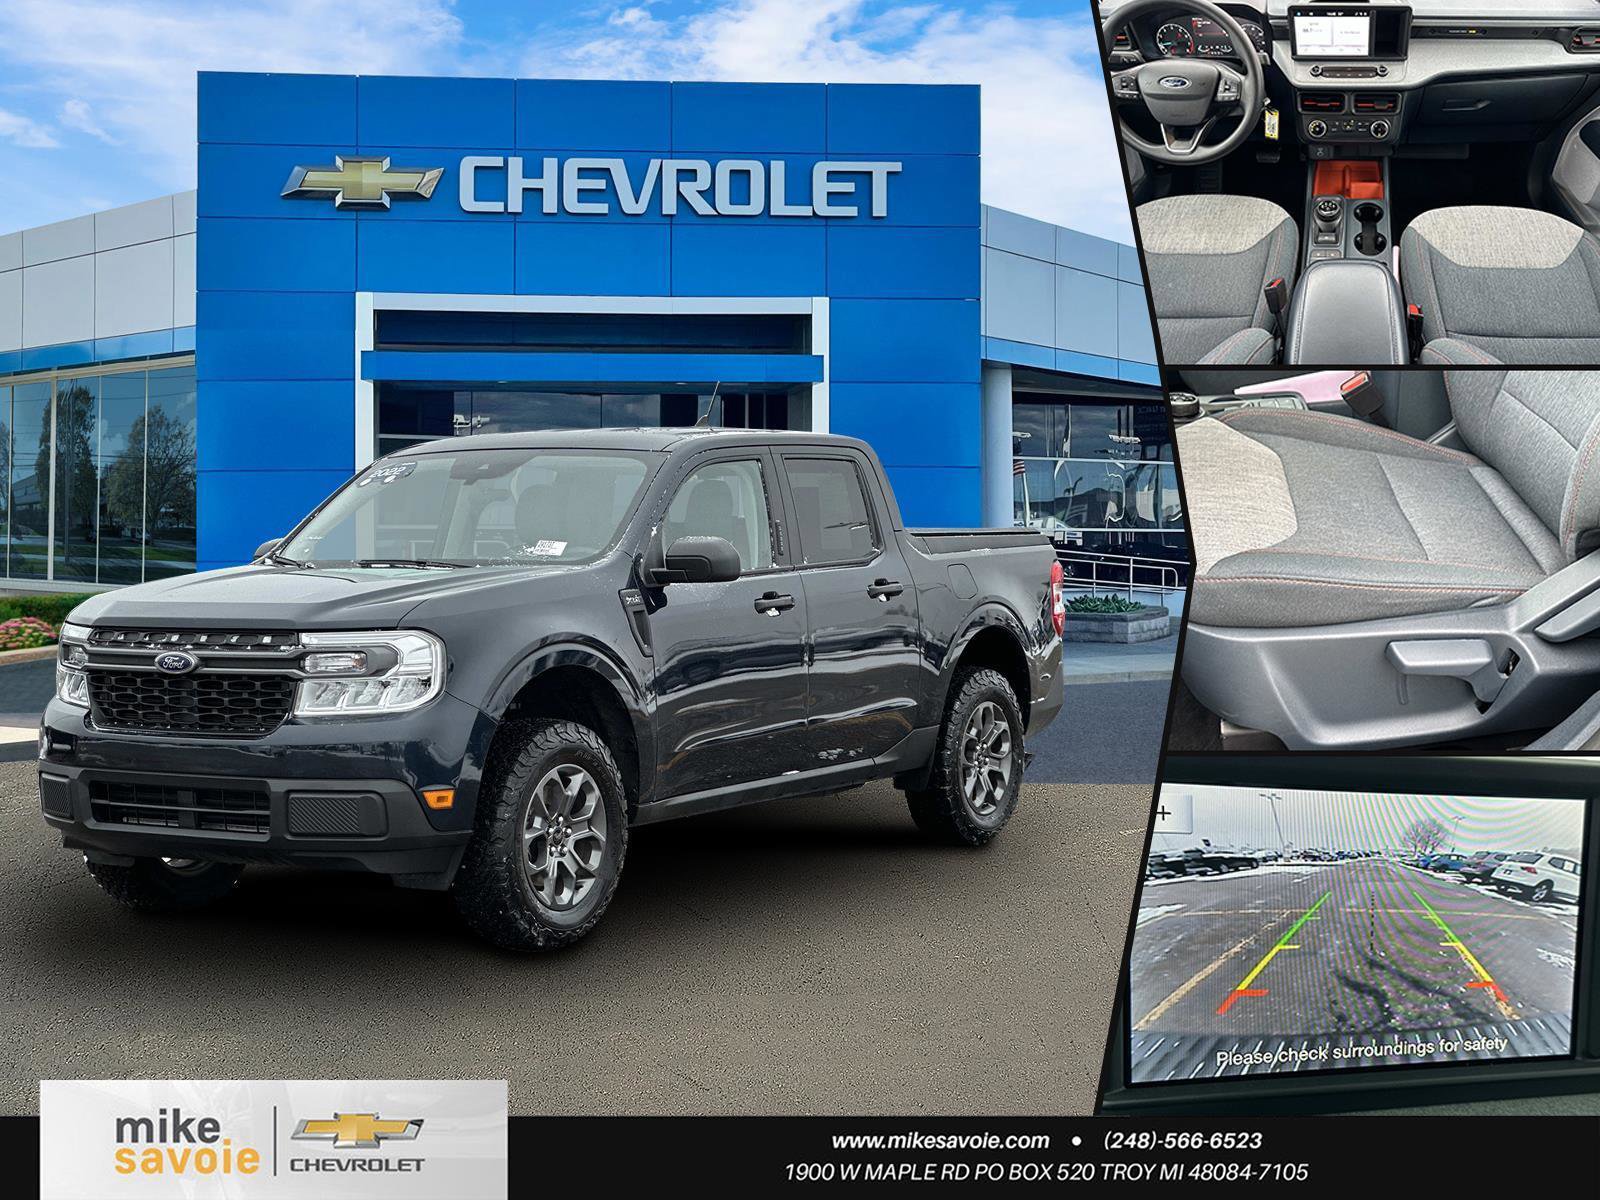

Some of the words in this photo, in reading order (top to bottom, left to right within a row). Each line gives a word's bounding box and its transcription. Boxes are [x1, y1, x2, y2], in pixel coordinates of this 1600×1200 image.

[459, 155, 903, 218] CHEVROLET
[162, 656, 185, 669] Ford
[1216, 1049, 1273, 1067] Please
[1279, 1046, 1328, 1063] check
[1333, 1040, 1435, 1059] surroundings
[1439, 1038, 1460, 1053] for
[1463, 1036, 1508, 1053] safety
